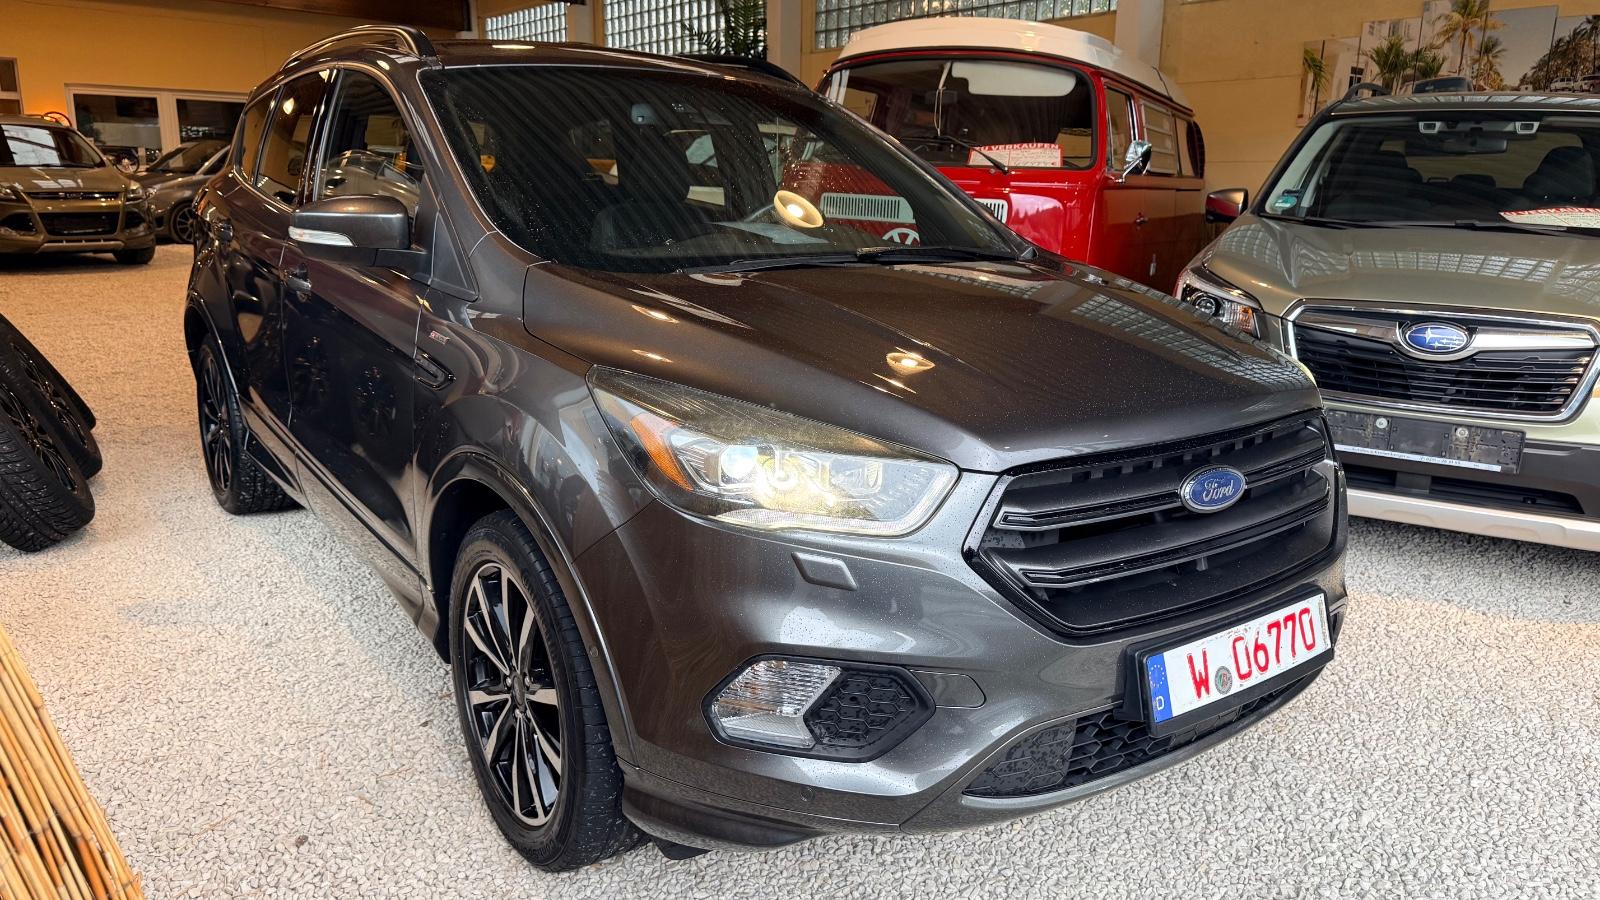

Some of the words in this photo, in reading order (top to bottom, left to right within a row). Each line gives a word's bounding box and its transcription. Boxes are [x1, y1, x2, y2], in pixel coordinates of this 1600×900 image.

[992, 143, 1059, 151] VERKAUFEN
[1203, 479, 1235, 502] Ford
[1186, 647, 1211, 700] W
[1232, 607, 1317, 681] 06770
[1156, 695, 1165, 711] D
